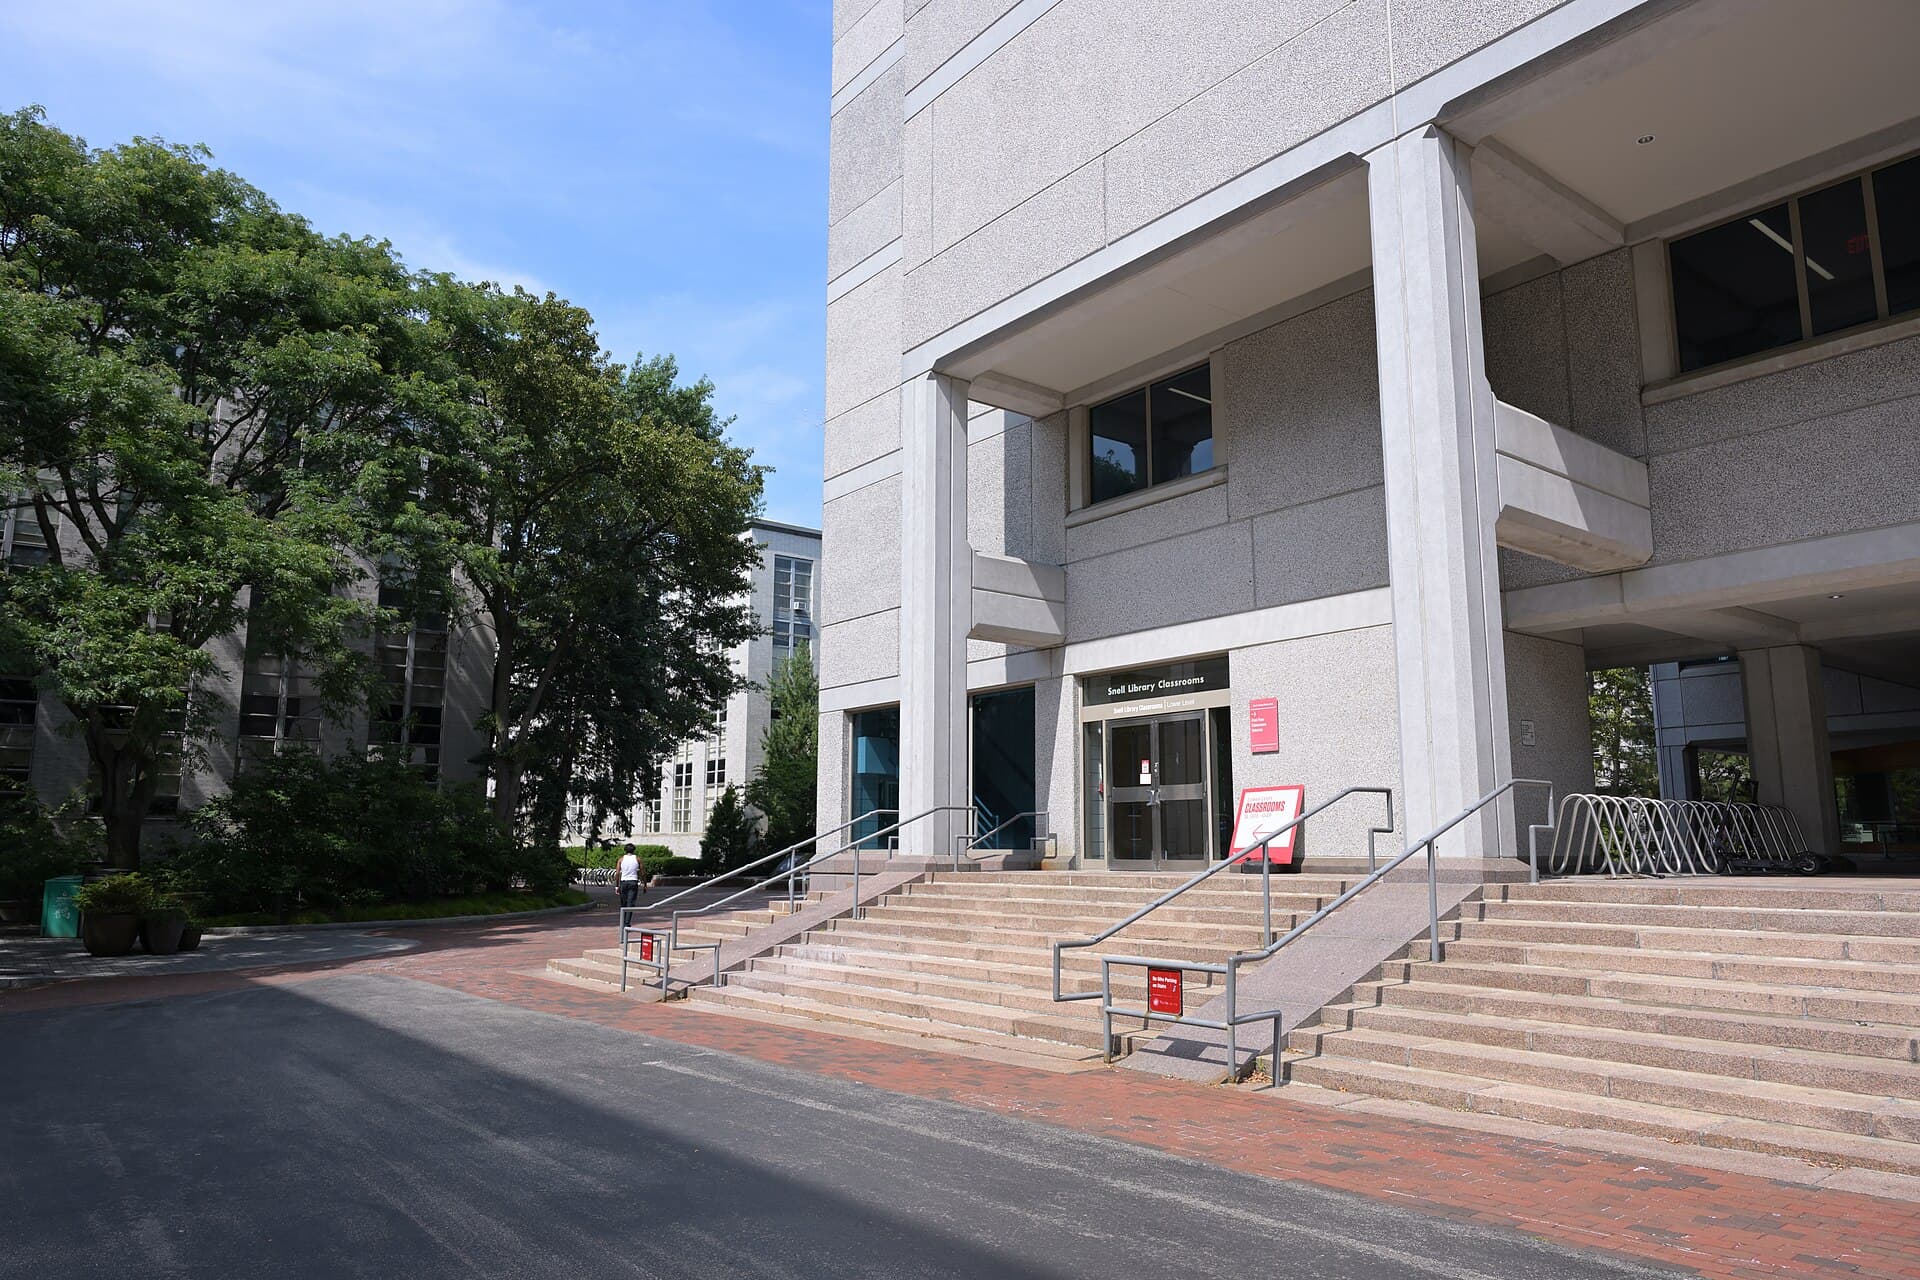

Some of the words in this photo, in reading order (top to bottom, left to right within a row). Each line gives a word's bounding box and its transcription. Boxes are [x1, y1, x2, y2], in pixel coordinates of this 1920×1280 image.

[1107, 684, 1126, 696] Snell
[1127, 683, 1155, 692] Library
[1157, 676, 1205, 689] Classrooms
[1124, 705, 1138, 713] Library
[1244, 800, 1286, 814] CLASSROOMS
